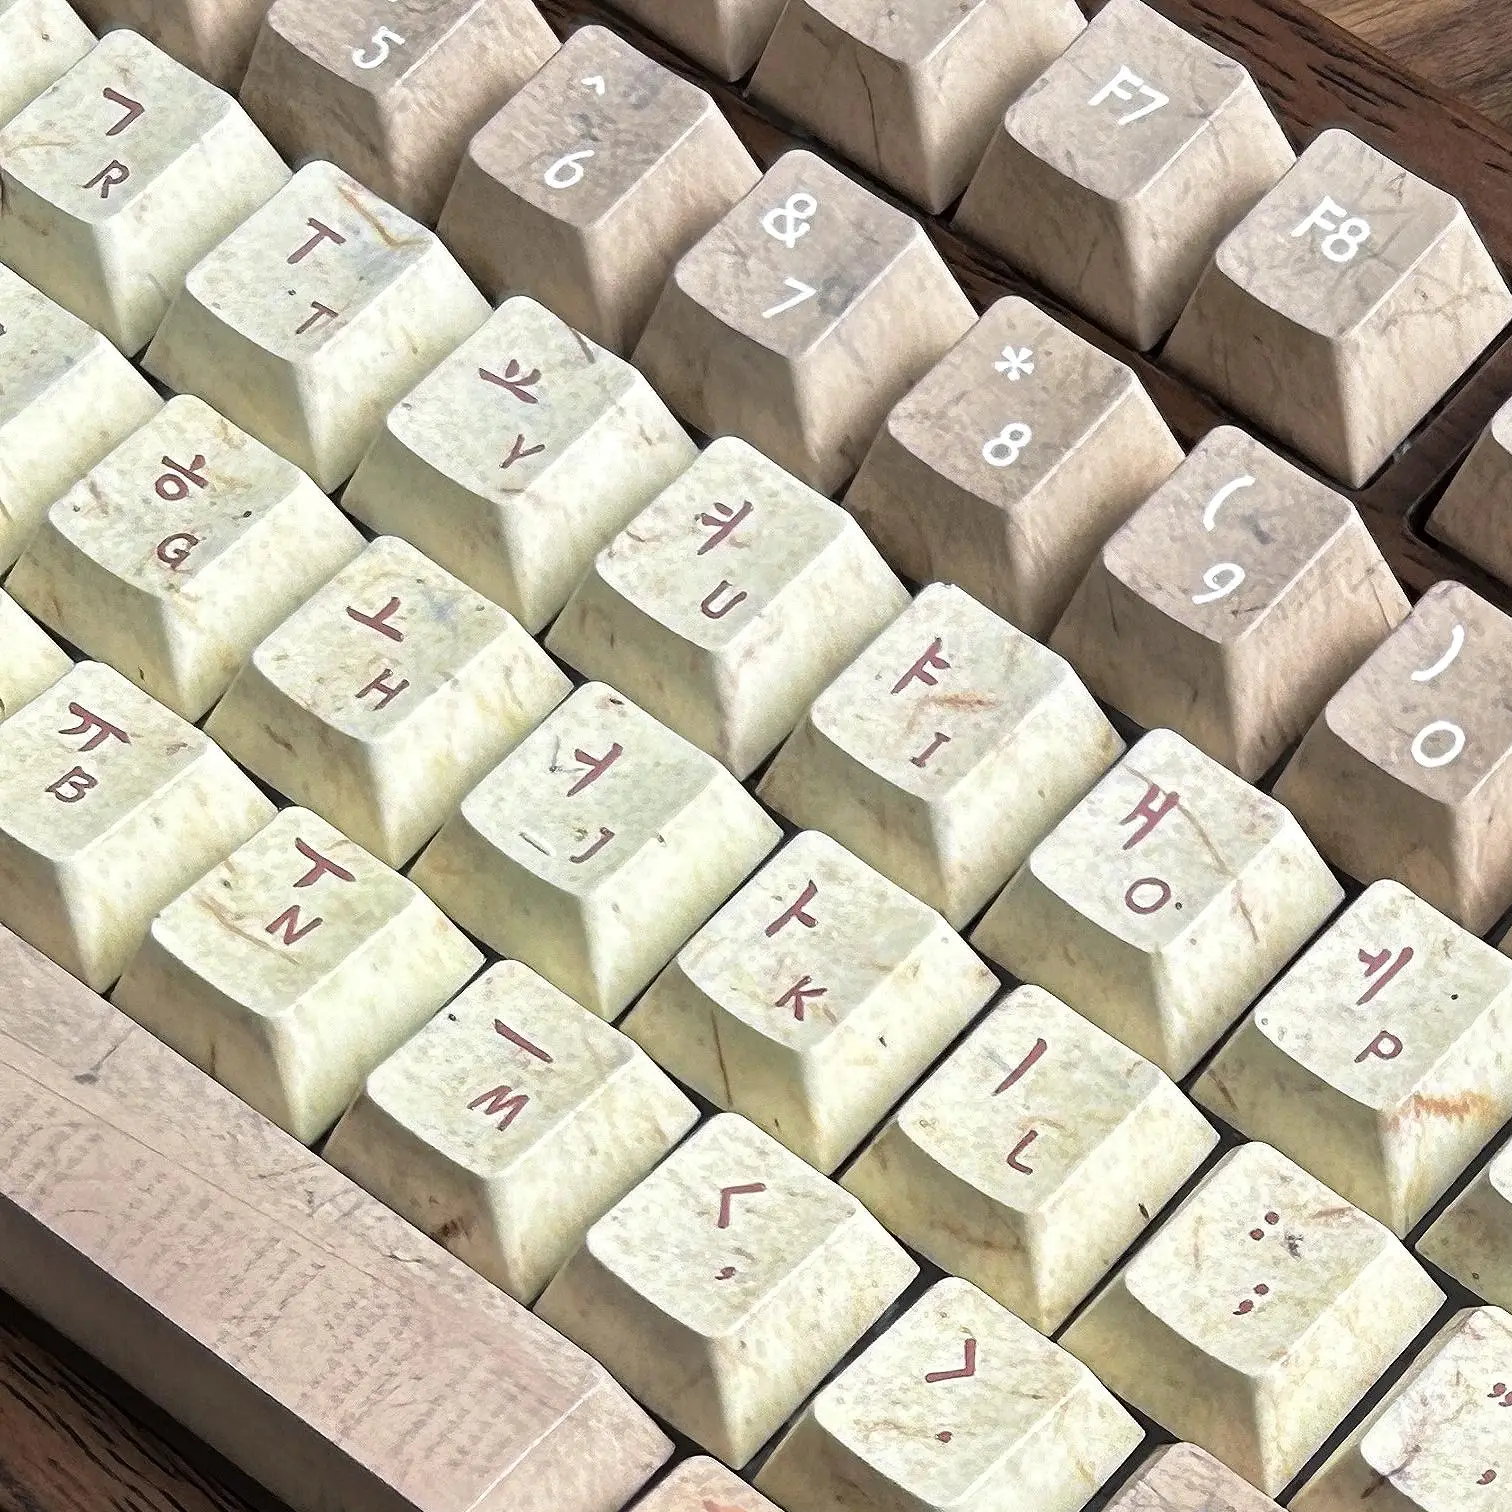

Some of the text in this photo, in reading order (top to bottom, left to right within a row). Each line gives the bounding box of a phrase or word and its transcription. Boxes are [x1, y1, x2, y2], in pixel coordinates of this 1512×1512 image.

[351, 29, 406, 70] 5
[1087, 63, 1170, 126] F7
[81, 159, 130, 199] R
[543, 149, 595, 189] 6
[1289, 194, 1372, 263] F8
[294, 300, 340, 335] T
[761, 275, 817, 319] 7
[498, 433, 546, 470] Y
[981, 422, 1032, 467] 8
[156, 532, 201, 573] G
[700, 579, 748, 620] U
[1191, 562, 1246, 605] 9
[354, 667, 410, 712] H
[908, 731, 952, 769] I
[1410, 720, 1466, 768] 0
[43, 765, 99, 804] B
[571, 826, 616, 865] J
[1124, 876, 1172, 916] O
[264, 904, 324, 947] N
[773, 975, 829, 1022] K
[1353, 1029, 1404, 1064] P
[466, 1084, 531, 1133] M
[1005, 1129, 1039, 1176] L
